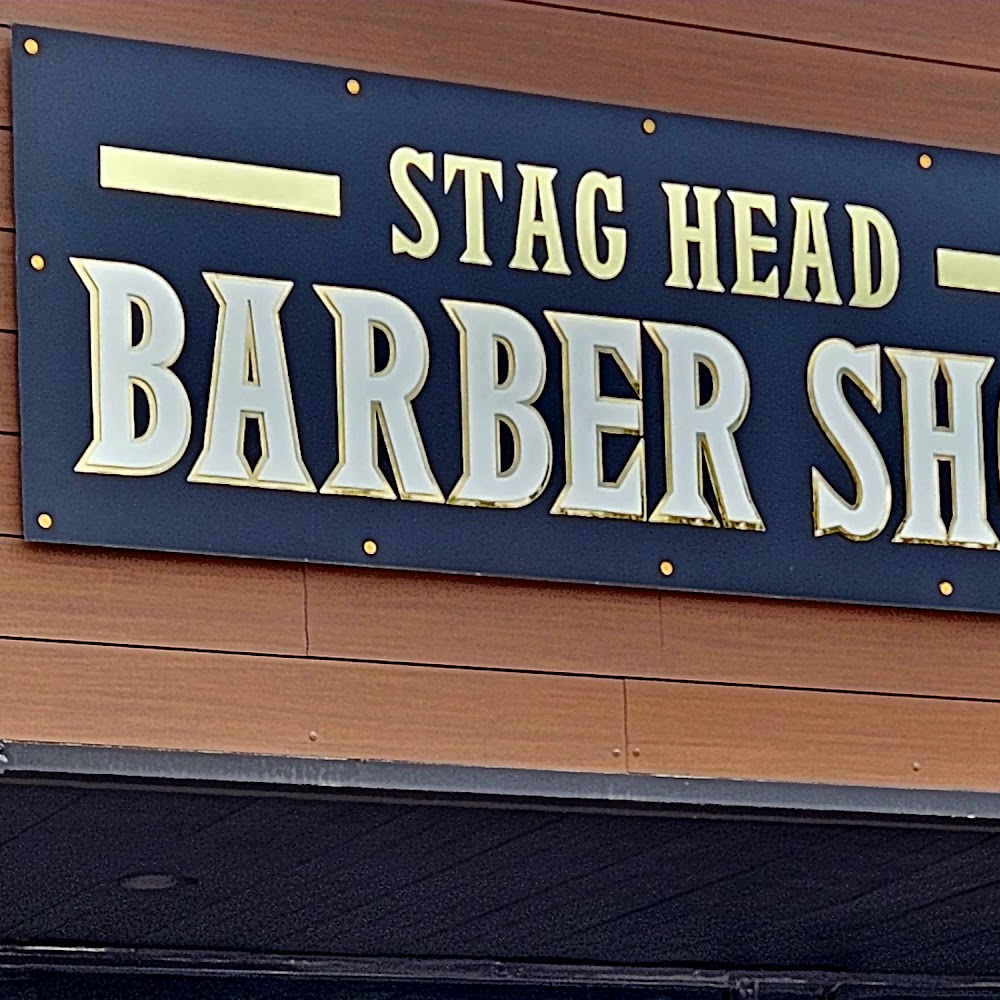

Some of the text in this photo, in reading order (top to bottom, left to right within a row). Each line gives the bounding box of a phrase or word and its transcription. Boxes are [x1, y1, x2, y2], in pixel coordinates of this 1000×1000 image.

[389, 146, 900, 308] STAG HEAD
[69, 256, 766, 532] BARBER
